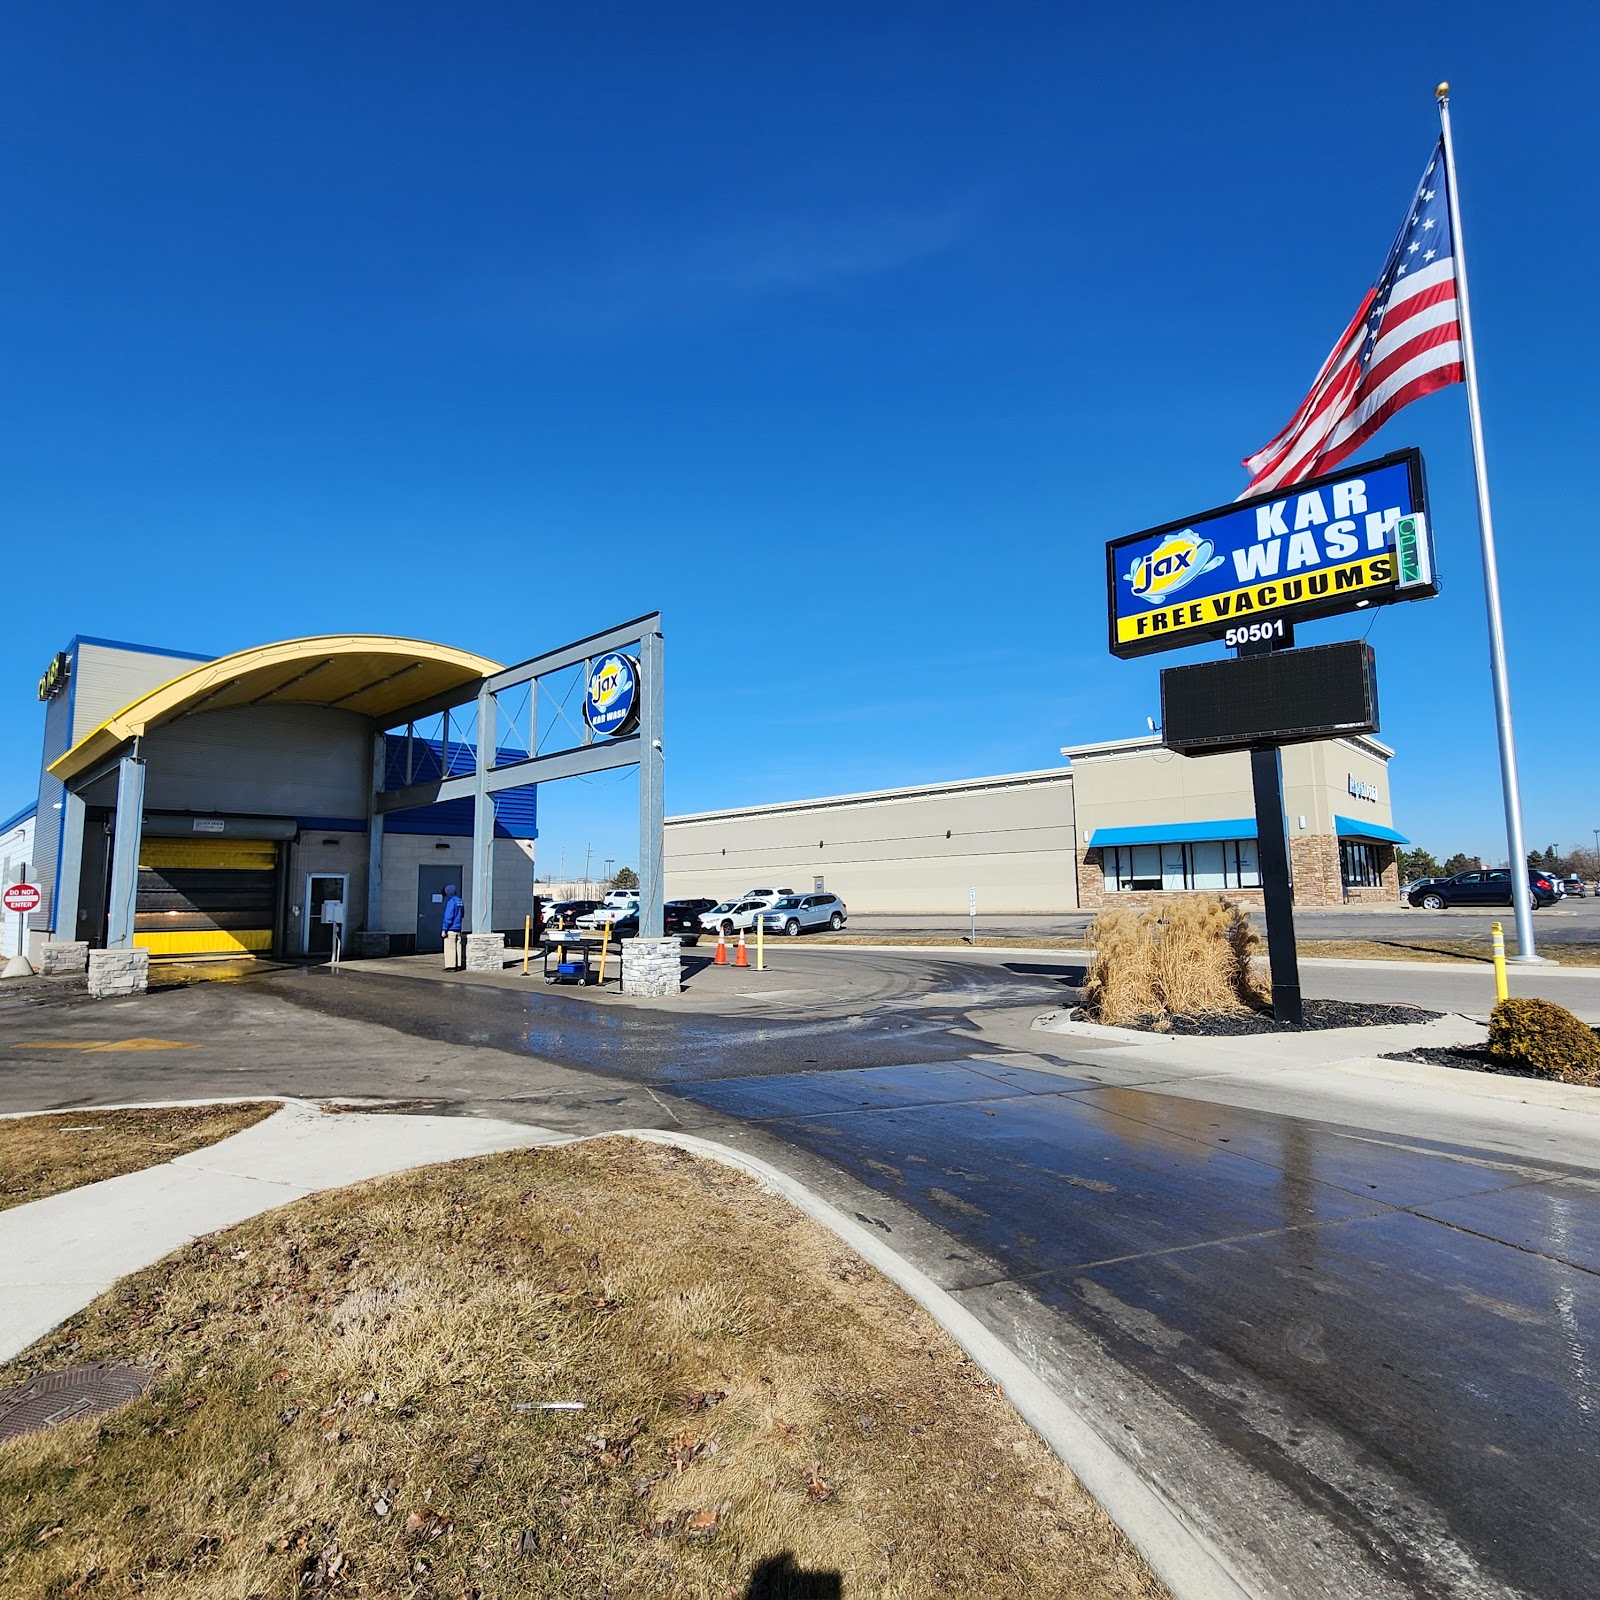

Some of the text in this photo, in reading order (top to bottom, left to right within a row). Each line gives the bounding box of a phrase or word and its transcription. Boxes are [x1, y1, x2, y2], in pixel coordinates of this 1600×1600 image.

[1255, 479, 1368, 541] KAR
[1232, 506, 1401, 583] WASH
[1399, 519, 1421, 583] OPEN
[1132, 548, 1193, 595] jax
[1136, 559, 1392, 635] FREE VACUUMS
[1225, 619, 1283, 646] 50501
[592, 673, 618, 704] jax
[592, 708, 627, 725] KAR WASH
[10, 901, 33, 909] ENTER
